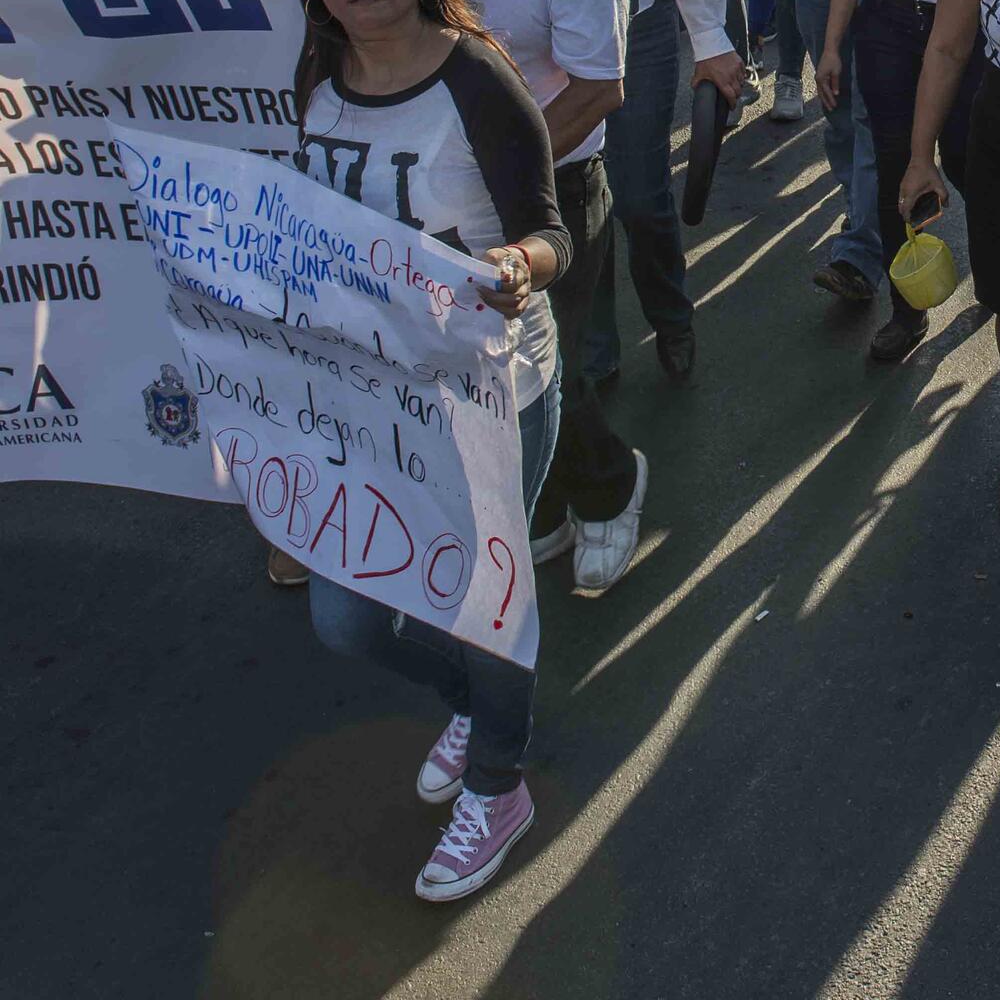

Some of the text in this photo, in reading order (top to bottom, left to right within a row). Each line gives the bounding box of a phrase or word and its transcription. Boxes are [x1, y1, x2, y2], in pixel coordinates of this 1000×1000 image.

[23, 81, 109, 119] PAÍS
[107, 85, 137, 119] Y
[15, 138, 84, 177] LOS
[113, 138, 238, 228] Dialogo
[4, 200, 116, 242] HASTA
[297, 380, 378, 467] dejan
